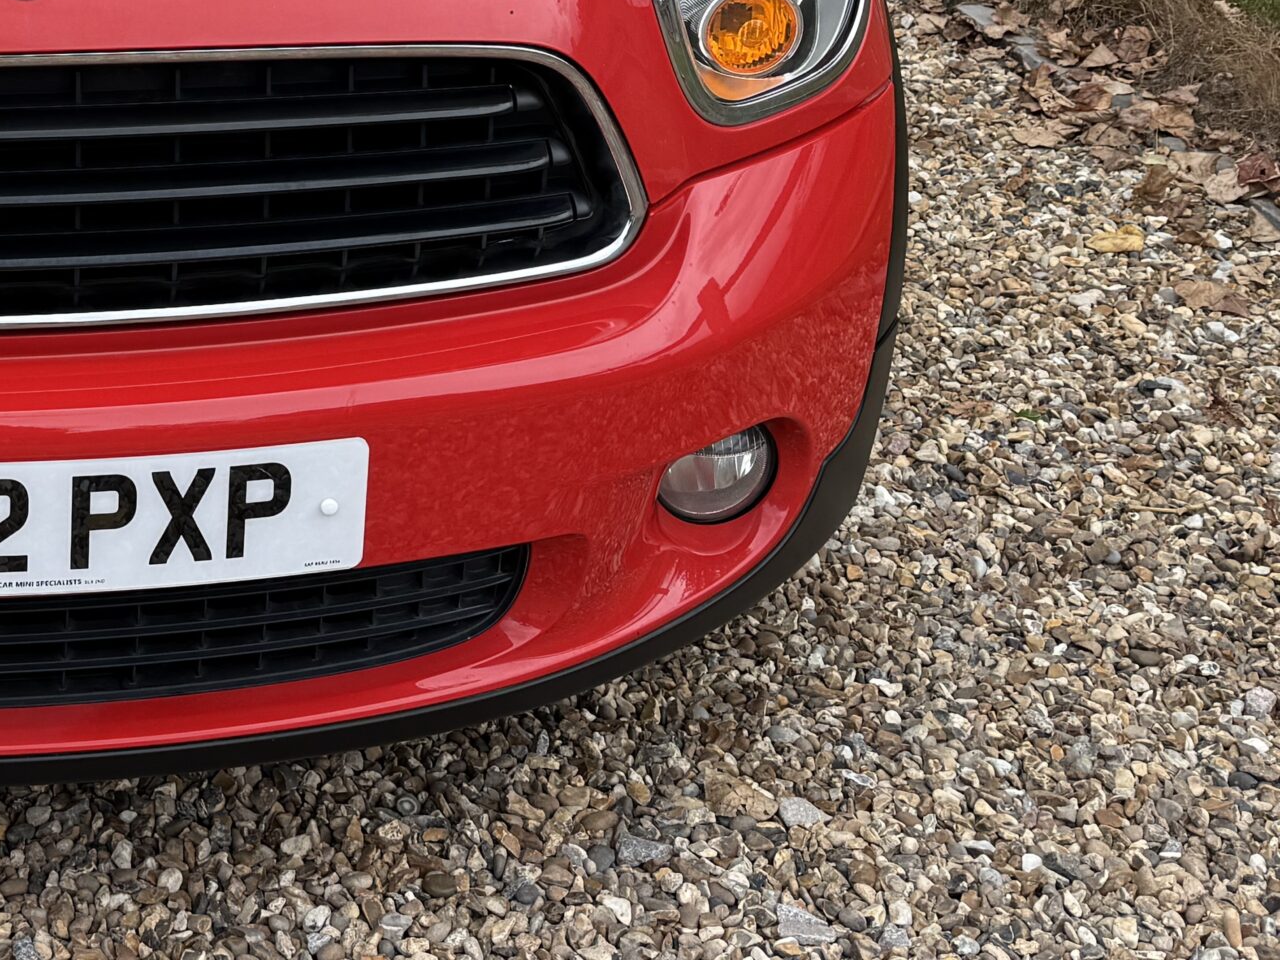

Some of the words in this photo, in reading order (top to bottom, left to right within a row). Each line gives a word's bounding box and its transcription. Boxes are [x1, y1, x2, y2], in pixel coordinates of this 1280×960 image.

[69, 462, 292, 570] PXP
[15, 580, 35, 588] MINI
[35, 578, 83, 587] SPECIALISTS
